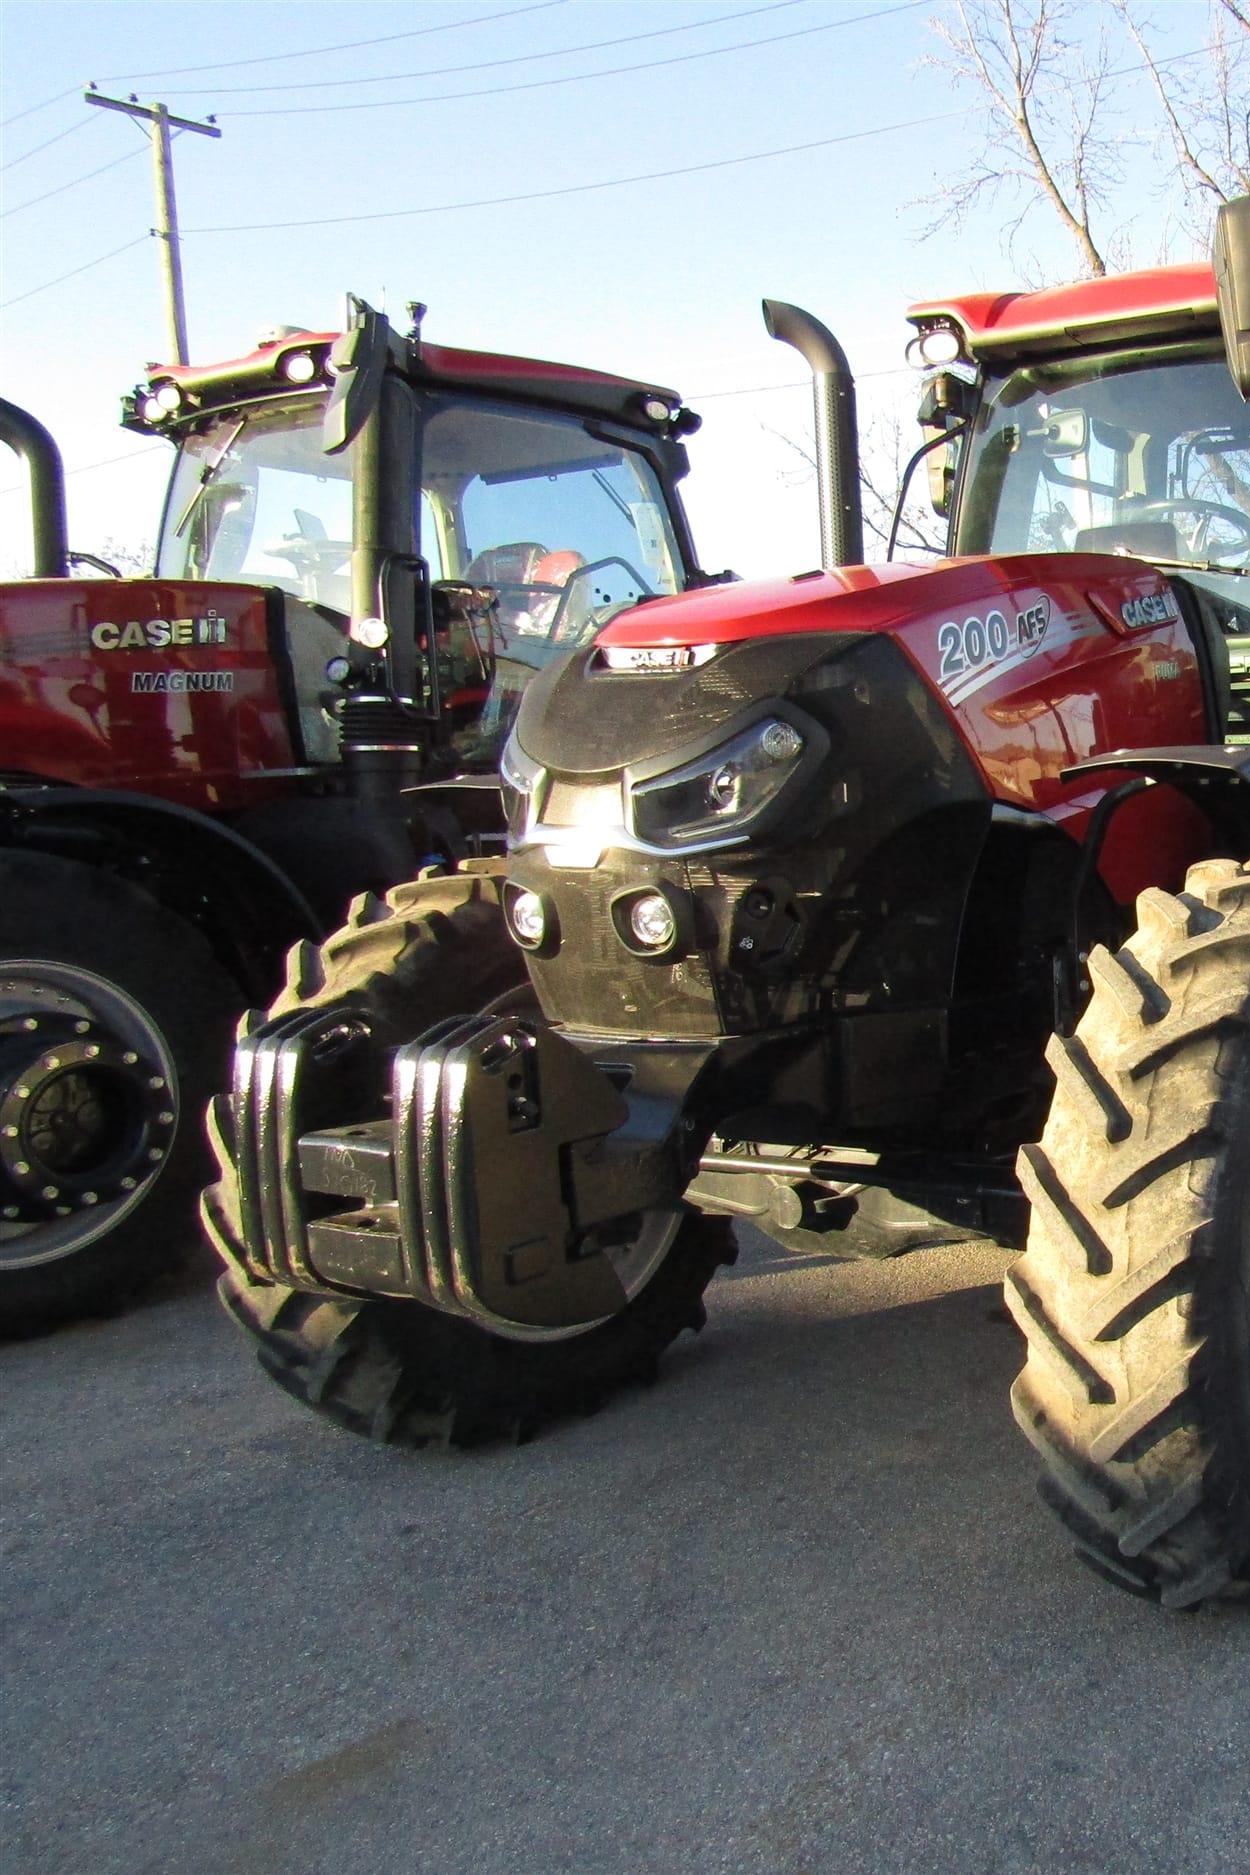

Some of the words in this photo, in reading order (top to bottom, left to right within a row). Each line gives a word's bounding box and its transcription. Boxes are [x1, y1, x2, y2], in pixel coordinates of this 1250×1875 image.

[1121, 595, 1165, 628] CASE
[91, 618, 193, 650] CASE
[937, 610, 1010, 678] 200
[1016, 605, 1047, 645] AFS
[628, 650, 675, 667] CASE
[131, 671, 234, 693] MAGNUM
